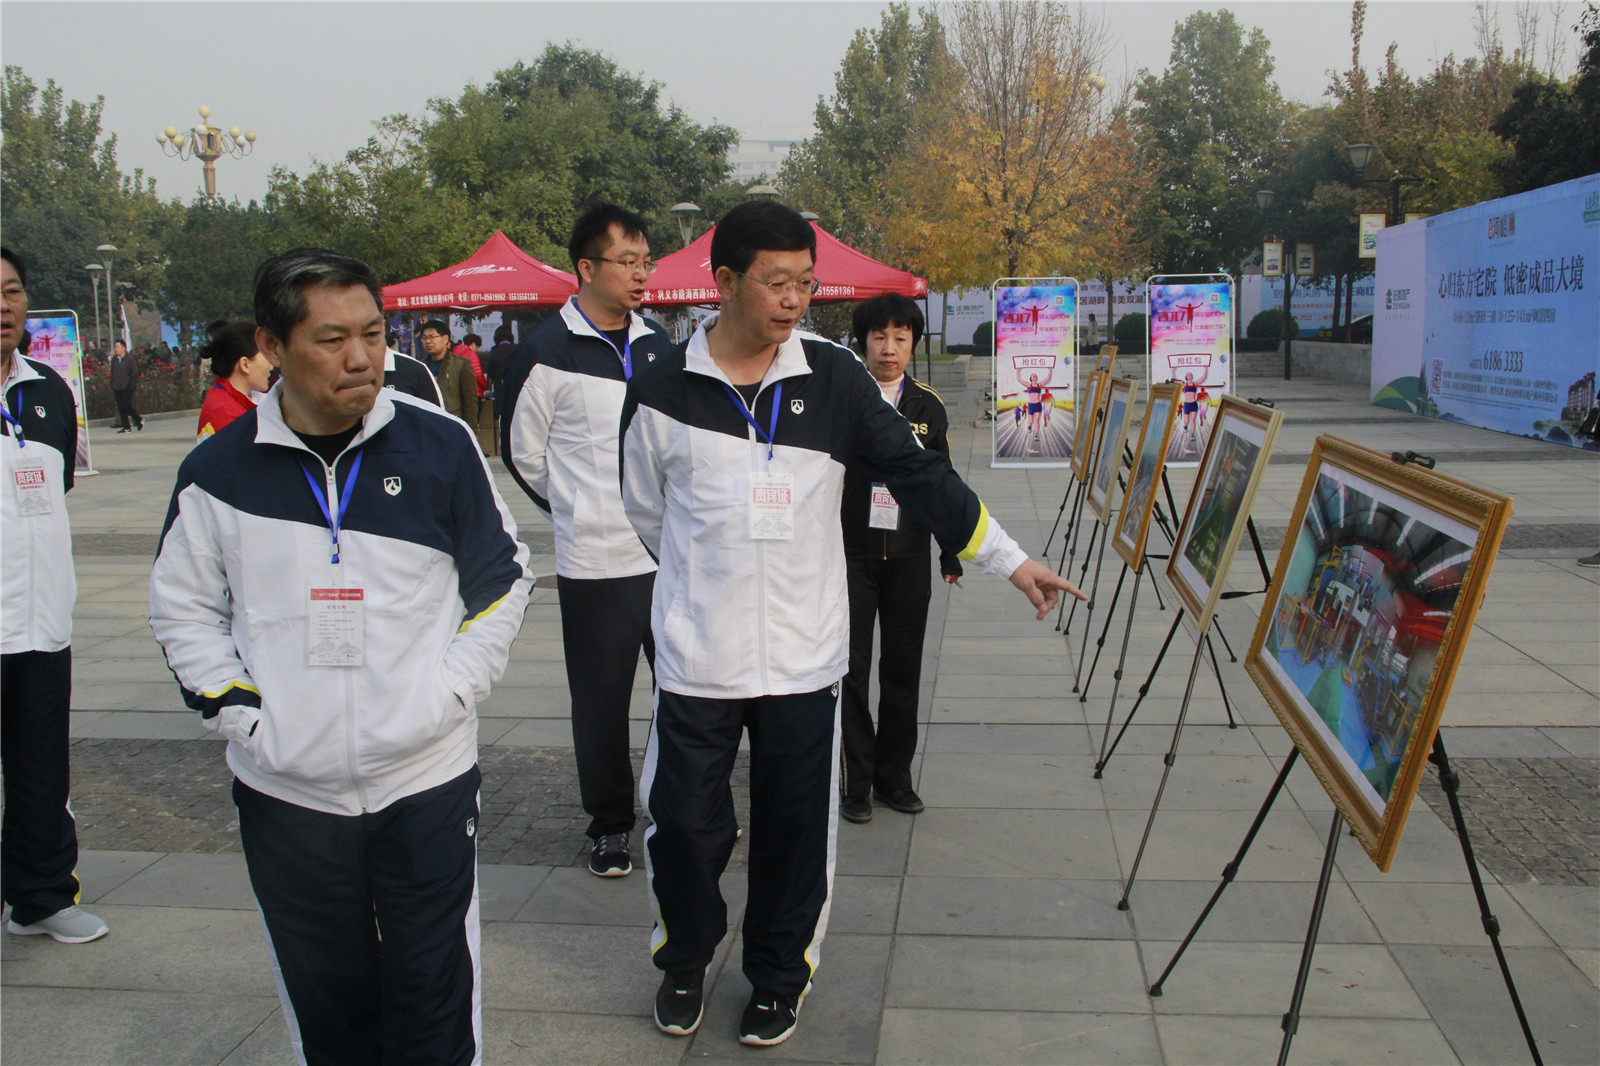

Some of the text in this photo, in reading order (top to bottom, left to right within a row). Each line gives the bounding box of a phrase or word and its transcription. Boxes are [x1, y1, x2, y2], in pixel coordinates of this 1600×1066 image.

[1439, 253, 1584, 300] 心归东方宅院 低密成品大境
[640, 287, 722, 302] 址：巩义市陇海西路167
[1003, 313, 1031, 324] 2017
[1158, 311, 1186, 322] 2017
[1022, 358, 1046, 367] 抢红包
[1177, 357, 1202, 365] 抢红包
[1483, 350, 1503, 371] 6186
[1503, 351, 1524, 373] 3333
[16, 471, 44, 484] 贵宾证
